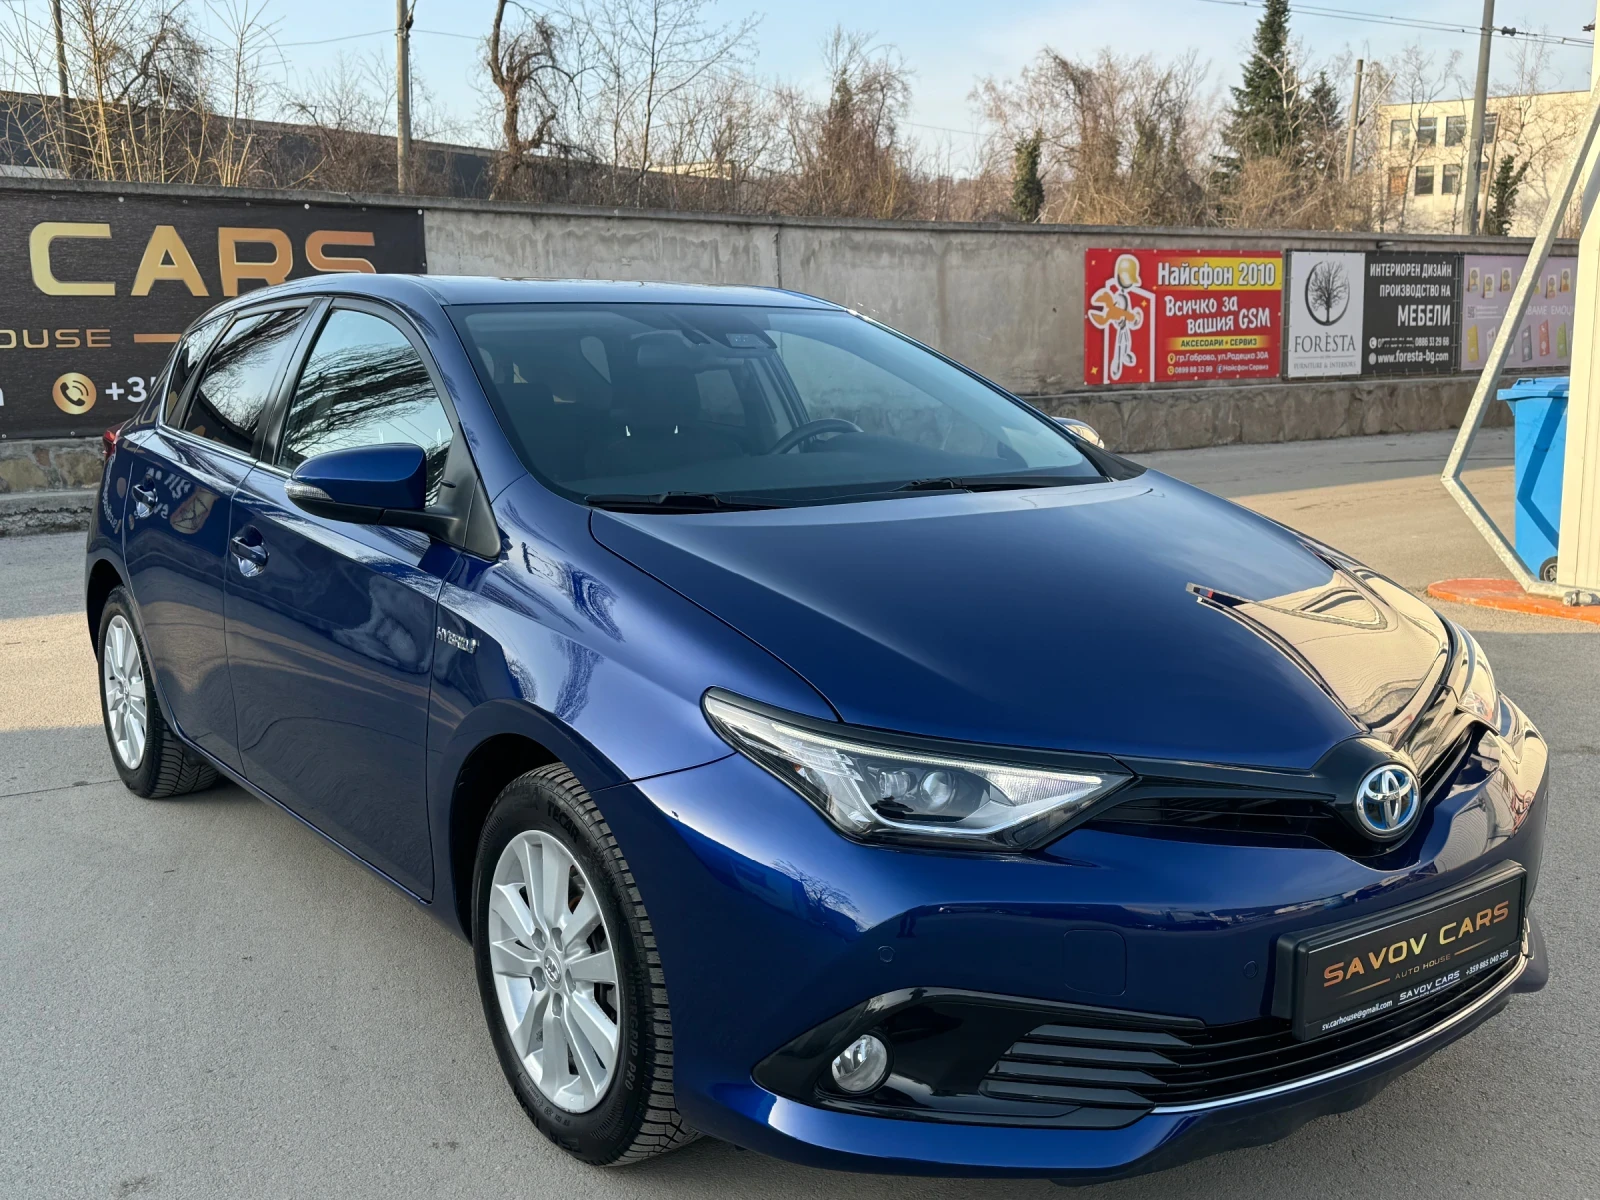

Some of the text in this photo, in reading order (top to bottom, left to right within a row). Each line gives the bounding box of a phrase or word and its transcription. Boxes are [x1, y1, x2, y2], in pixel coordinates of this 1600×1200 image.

[29, 221, 376, 297] CARS
[1370, 261, 1452, 278] ИНТЕРИОРЕН ДИЗАЙН
[1157, 262, 1275, 289] Найсфон 2010
[1379, 284, 1451, 298] ПРОИЗВОДСТВО НА
[1164, 295, 1239, 317] Всичко за
[1397, 304, 1451, 327] МЕБЕЛИ
[1187, 307, 1271, 335] вашия GSM
[1180, 338, 1257, 348] АКСЕСОАРИ СЕРВИЗ
[1294, 331, 1357, 353] FORÈSTA
[1377, 349, 1449, 364] www.foresta-bg.com
[1323, 900, 1509, 987] SAVOV CARS
[1395, 953, 1451, 980] AUTO HOUSE
[1321, 999, 1393, 1032] sv.carhouse@gmail.com
[1399, 981, 1433, 1001] SAVOV
[1434, 969, 1461, 987] CARS
